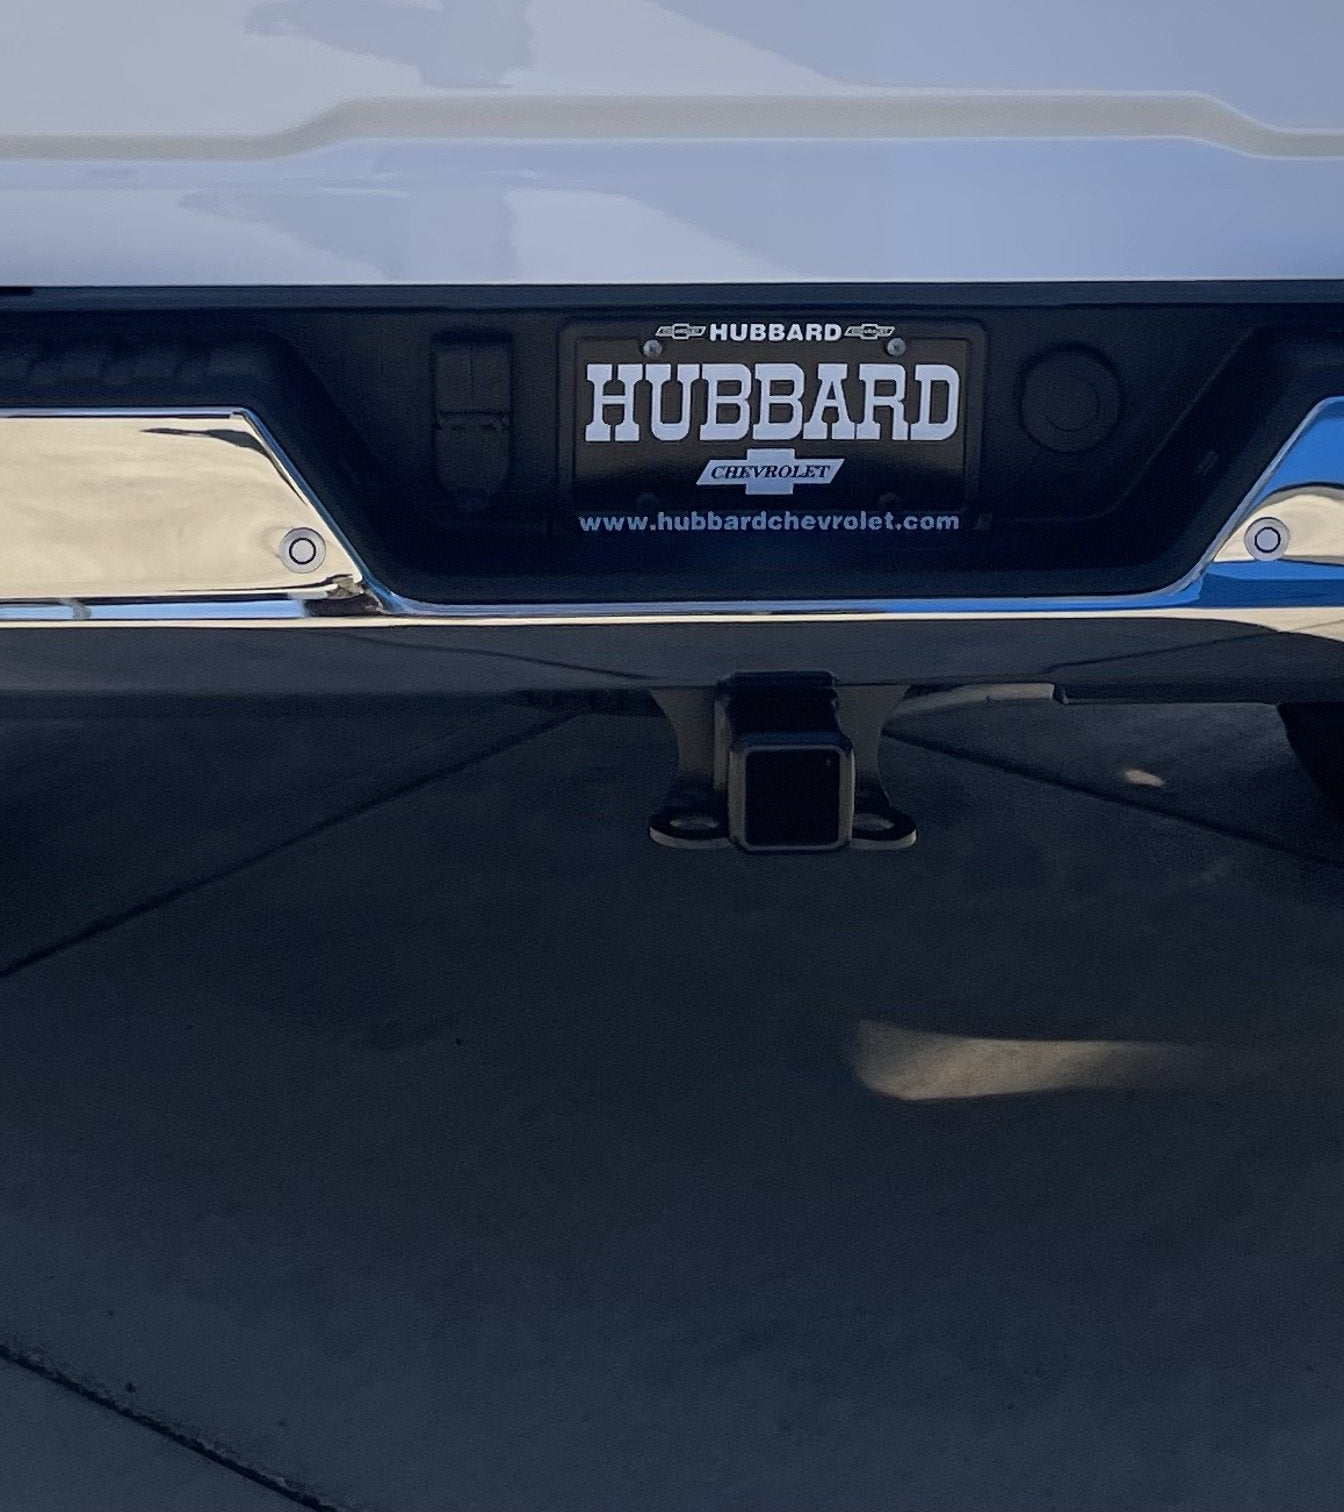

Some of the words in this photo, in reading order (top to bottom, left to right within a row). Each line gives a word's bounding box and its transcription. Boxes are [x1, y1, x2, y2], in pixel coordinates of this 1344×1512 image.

[709, 323, 843, 342] HUBBARD
[585, 363, 960, 441] HUBBARD
[710, 464, 831, 480] CHEVROLET
[578, 510, 960, 533] www.hubbardchevrolet.com
